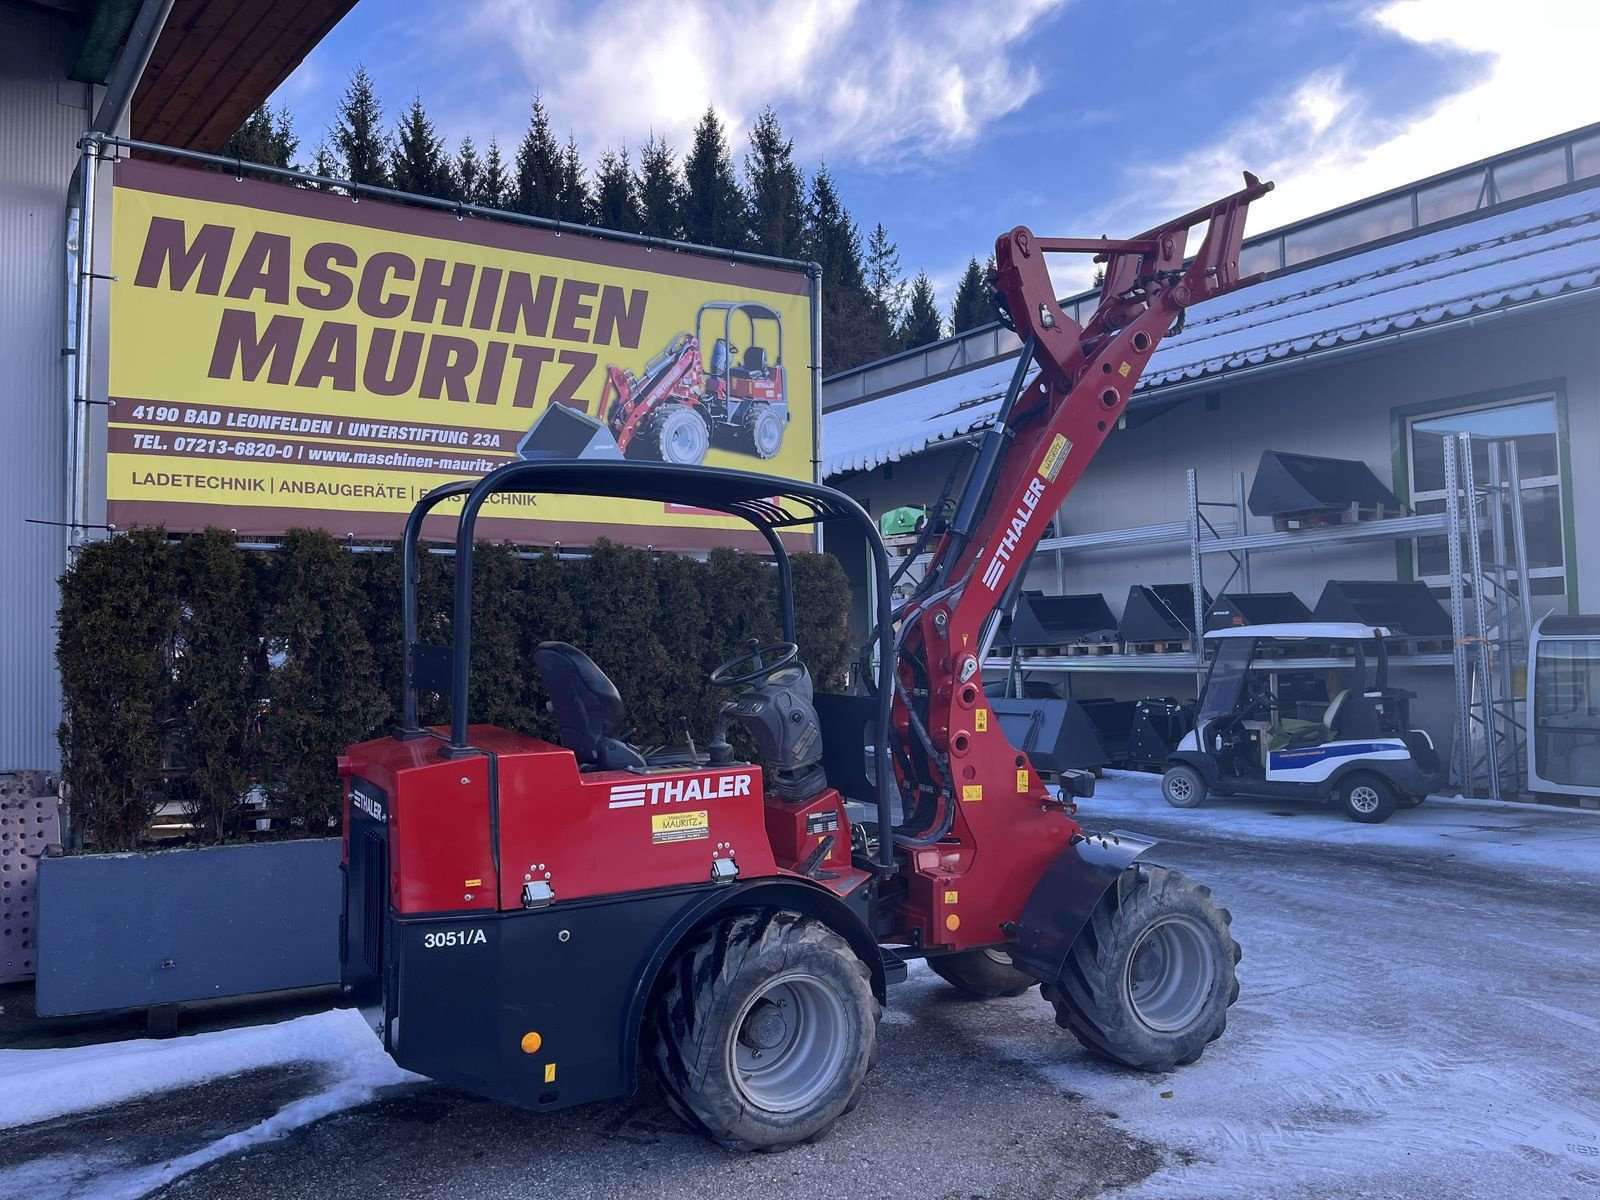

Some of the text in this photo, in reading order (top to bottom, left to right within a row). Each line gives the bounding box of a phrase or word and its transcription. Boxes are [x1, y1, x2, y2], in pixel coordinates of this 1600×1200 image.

[134, 216, 649, 349] MASCHINEN
[208, 309, 598, 413] MAURITZ
[133, 405, 500, 448] 4190 BAD LEONFELDEN UNTERSTIFTUNG 23A
[133, 433, 167, 450] TEL.
[173, 437, 293, 458] 07213-6820-0
[132, 471, 265, 492] LADETECHNIK
[279, 480, 406, 499] ANBAUGERÄTE
[995, 477, 1048, 564] THALER
[647, 774, 752, 805] THALER
[357, 792, 382, 822] THALER
[662, 817, 698, 829] MAURITZ
[424, 929, 487, 948] 3051/A
